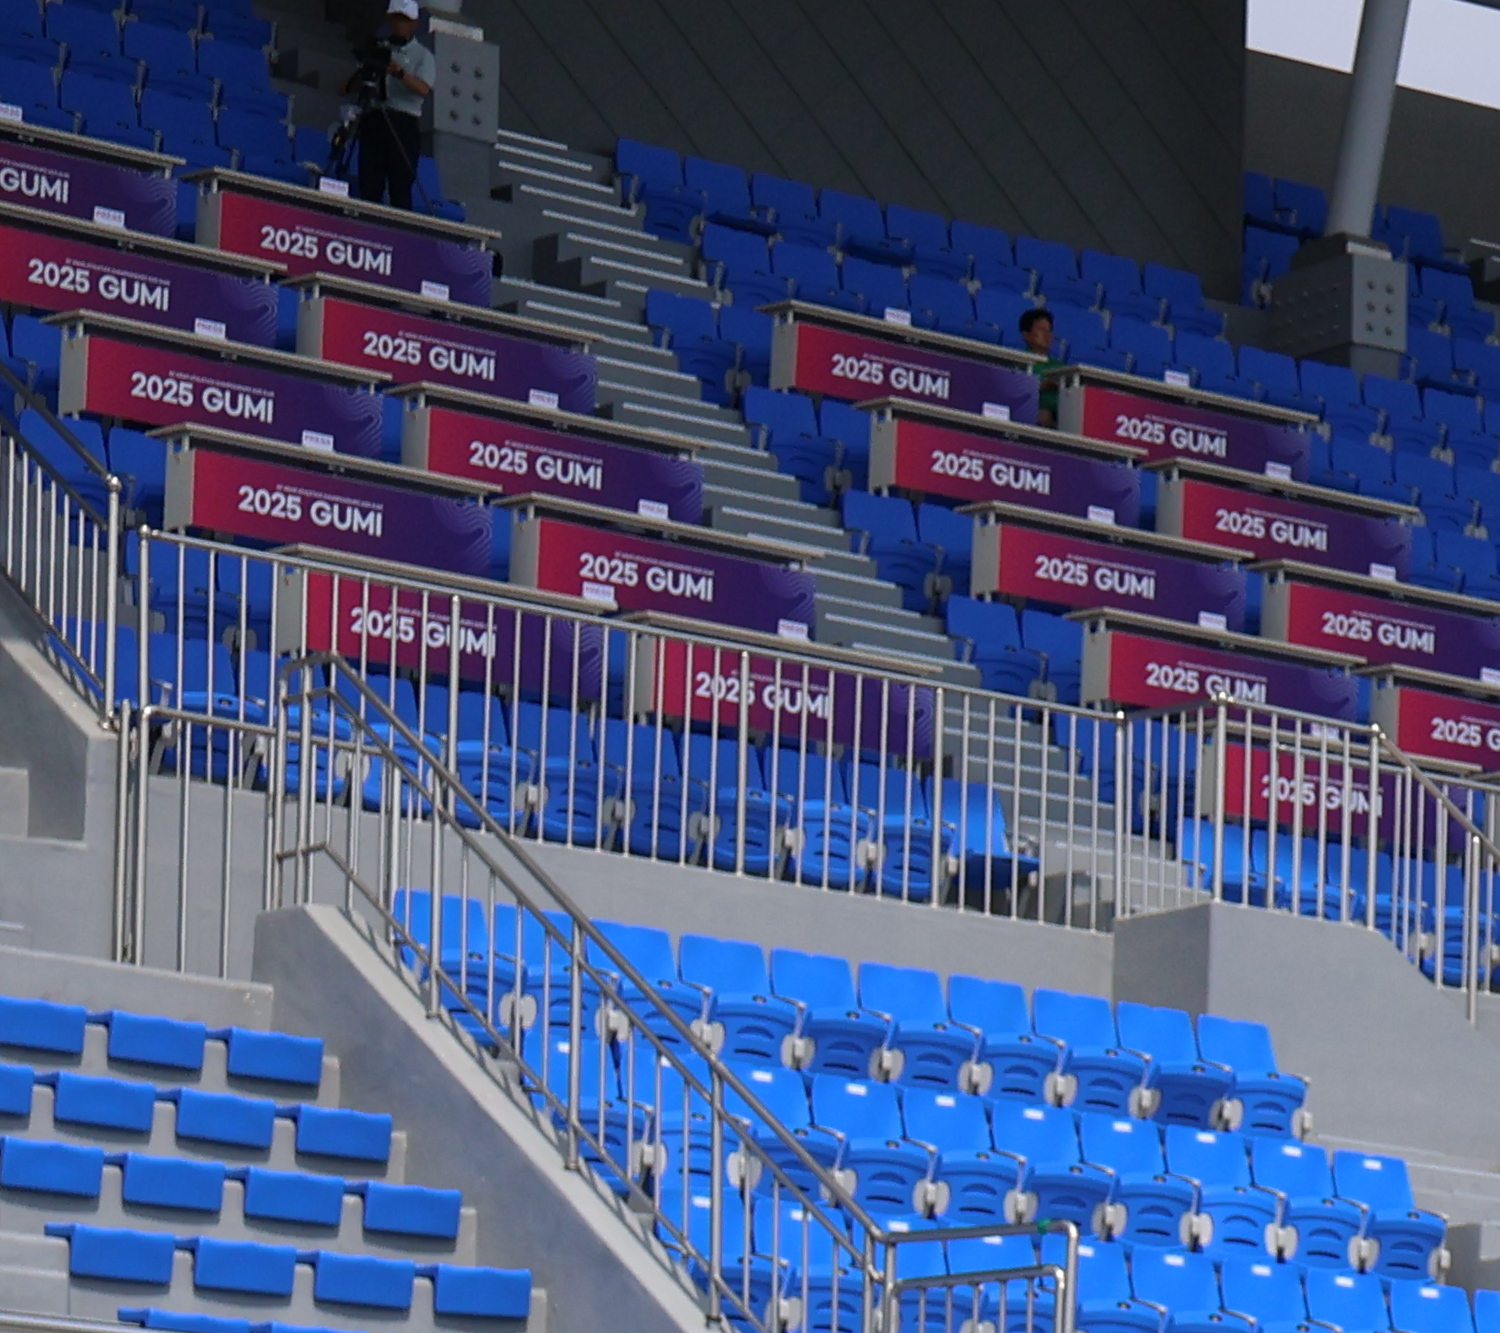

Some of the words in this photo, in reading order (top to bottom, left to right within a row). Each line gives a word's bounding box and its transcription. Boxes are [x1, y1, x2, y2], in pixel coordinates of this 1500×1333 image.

[0, 167, 69, 204] GUMI
[260, 225, 318, 259] 2025
[326, 241, 391, 276] GUMI
[28, 258, 90, 294] 2025
[98, 274, 169, 312] GUMI
[363, 331, 421, 365] 2025
[429, 345, 495, 381] GUMI
[831, 353, 884, 385] 2025
[890, 367, 949, 399] GUMI
[131, 371, 194, 407] 2025
[202, 386, 273, 424] GUMI
[1115, 415, 1165, 445] 2025
[1171, 427, 1226, 457] GUMI
[469, 440, 528, 475] 2025
[535, 455, 602, 491] GUMI
[931, 450, 984, 481] 2025
[990, 463, 1050, 495] GUMI
[238, 485, 302, 521] 2025
[310, 499, 382, 538] GUMI
[1215, 509, 1265, 538] 2025
[1271, 521, 1327, 551] GUMI
[579, 552, 638, 587] 2025
[646, 566, 713, 602] GUMI
[1035, 555, 1088, 586] 2025
[1095, 568, 1155, 599] GUMI
[1322, 611, 1372, 641] 2025
[1378, 623, 1434, 655] GUMI
[1145, 662, 1198, 693] 2025
[1205, 675, 1267, 703] GUMI
[1431, 717, 1482, 746] 2025
